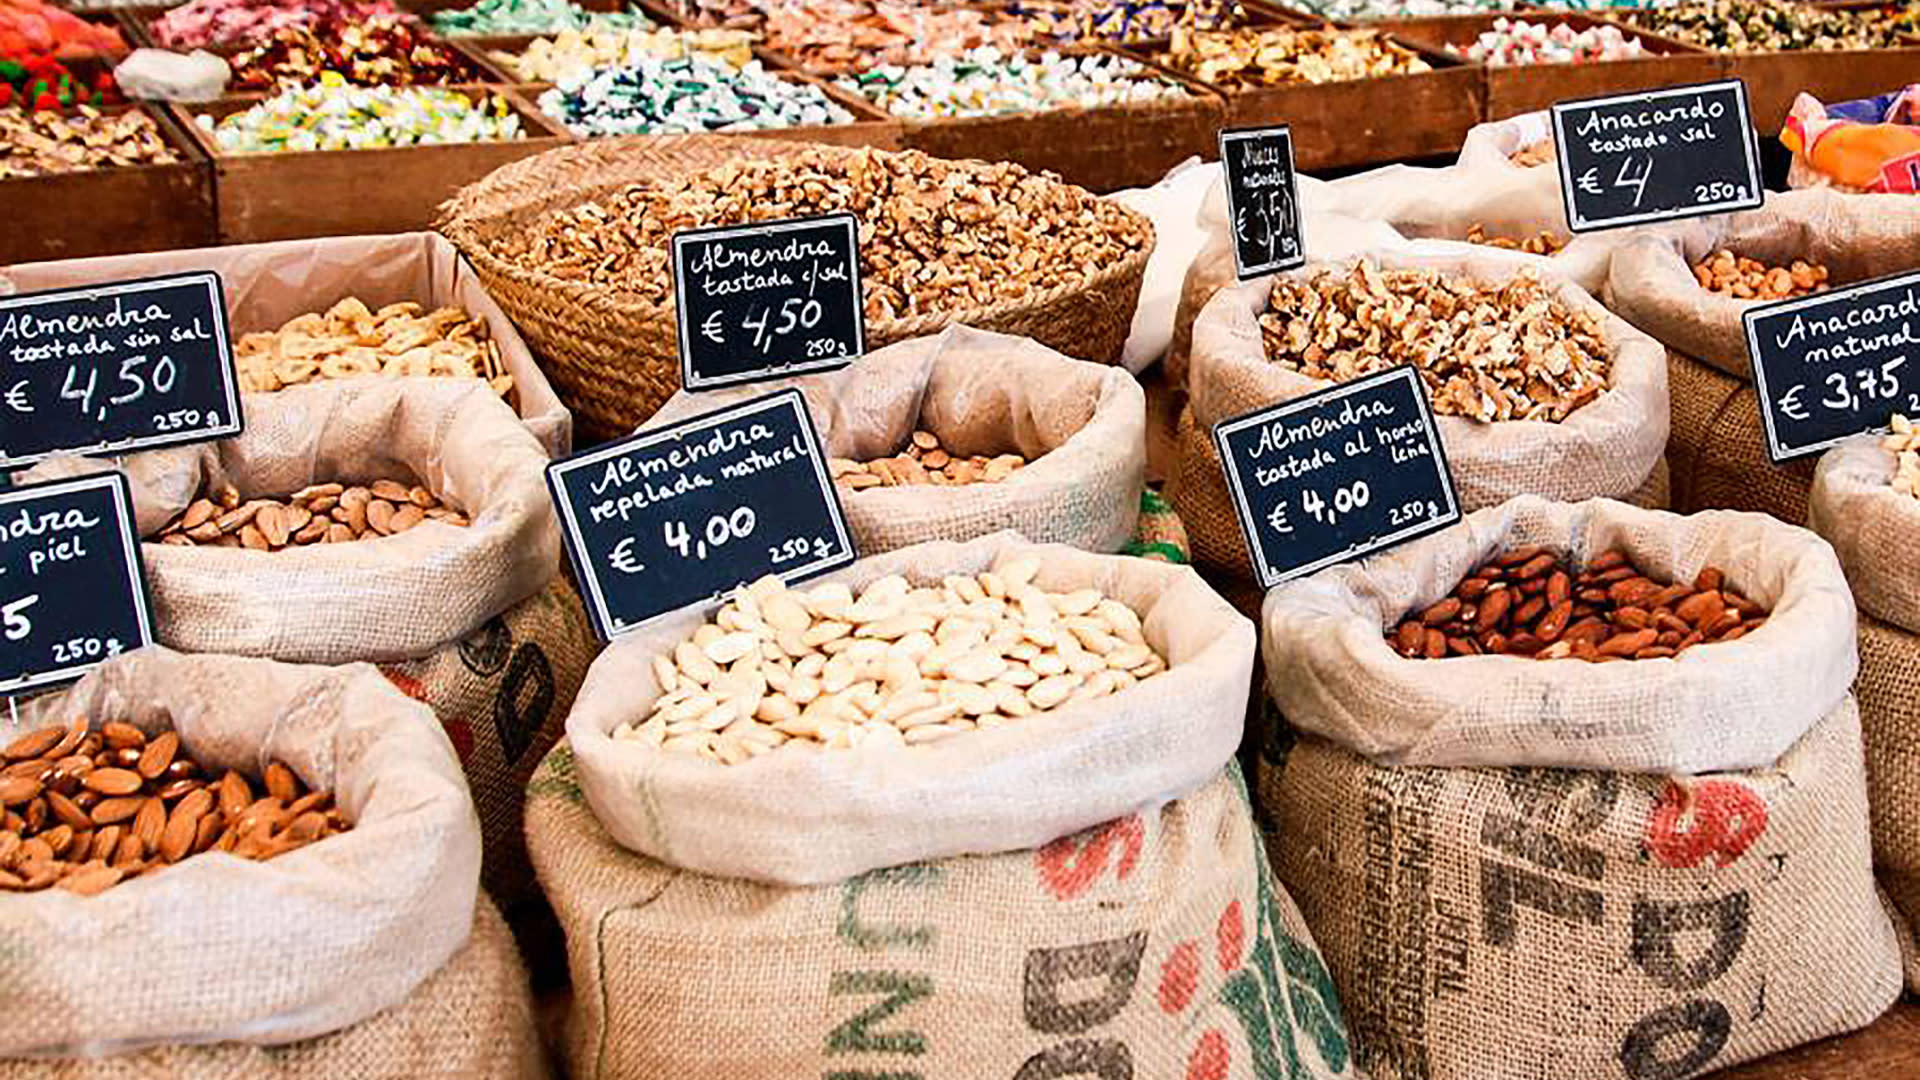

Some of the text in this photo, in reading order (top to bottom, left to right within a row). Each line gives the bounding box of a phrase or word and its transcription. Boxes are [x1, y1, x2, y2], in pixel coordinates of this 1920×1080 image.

[1576, 96, 1725, 137] Anacardo
[1588, 122, 1716, 153] tostado sal
[1577, 155, 1654, 207] € 4
[690, 238, 837, 274] Almendra
[702, 268, 794, 296] tostada
[0, 297, 171, 341] Almendra
[10, 317, 212, 363] tostada sin sal
[701, 298, 822, 354] € 4,50
[1776, 289, 1920, 349] Anacard
[1805, 322, 1920, 363] natural
[4, 355, 176, 421] € 4,50
[1777, 356, 1907, 420] € 3,75
[1248, 399, 1395, 459] Almendra
[590, 424, 774, 494] Almendra
[590, 434, 808, 522] repelada natural
[1255, 448, 1336, 487] tostada
[1345, 431, 1372, 457] al
[1267, 480, 1370, 533] € 4,00
[29, 536, 87, 574] piel
[608, 506, 757, 573] € 4,00
[820, 864, 948, 1080] UN
